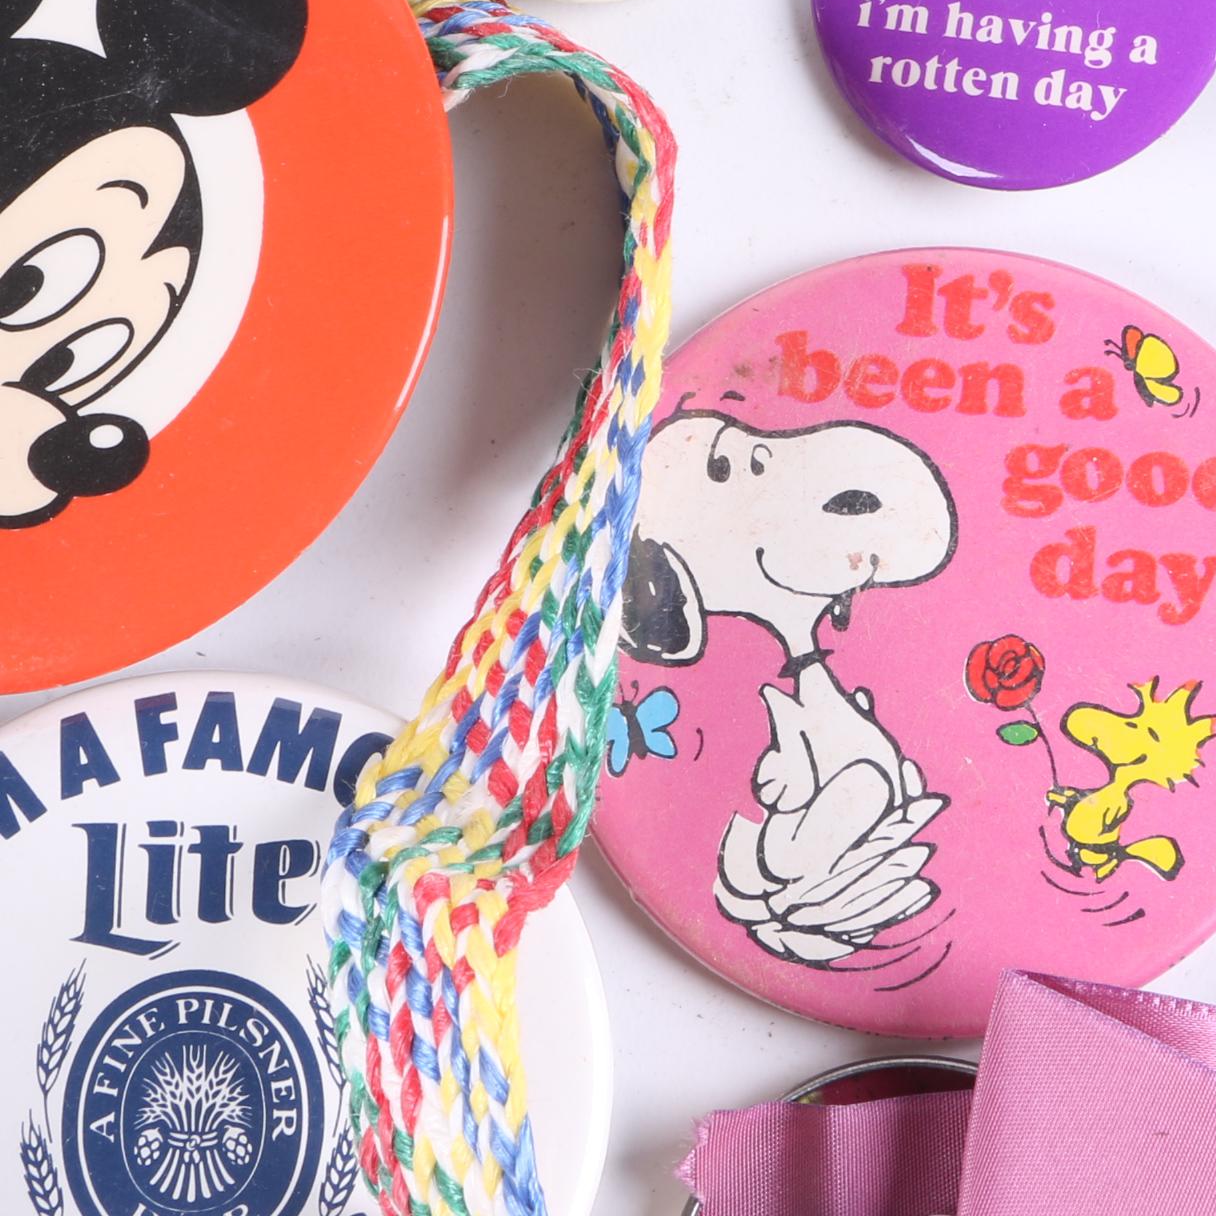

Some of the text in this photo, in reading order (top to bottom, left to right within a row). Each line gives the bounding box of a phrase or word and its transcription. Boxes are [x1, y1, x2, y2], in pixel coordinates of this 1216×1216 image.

[943, 1, 1116, 69] having
[1129, 34, 1158, 65] a
[868, 55, 1127, 121] rotten day
[896, 263, 1055, 344] It's
[775, 330, 1118, 421] been a
[60, 712, 121, 800] A
[69, 820, 320, 960] Lite
[90, 998, 298, 1143] A FINE PILSNER
